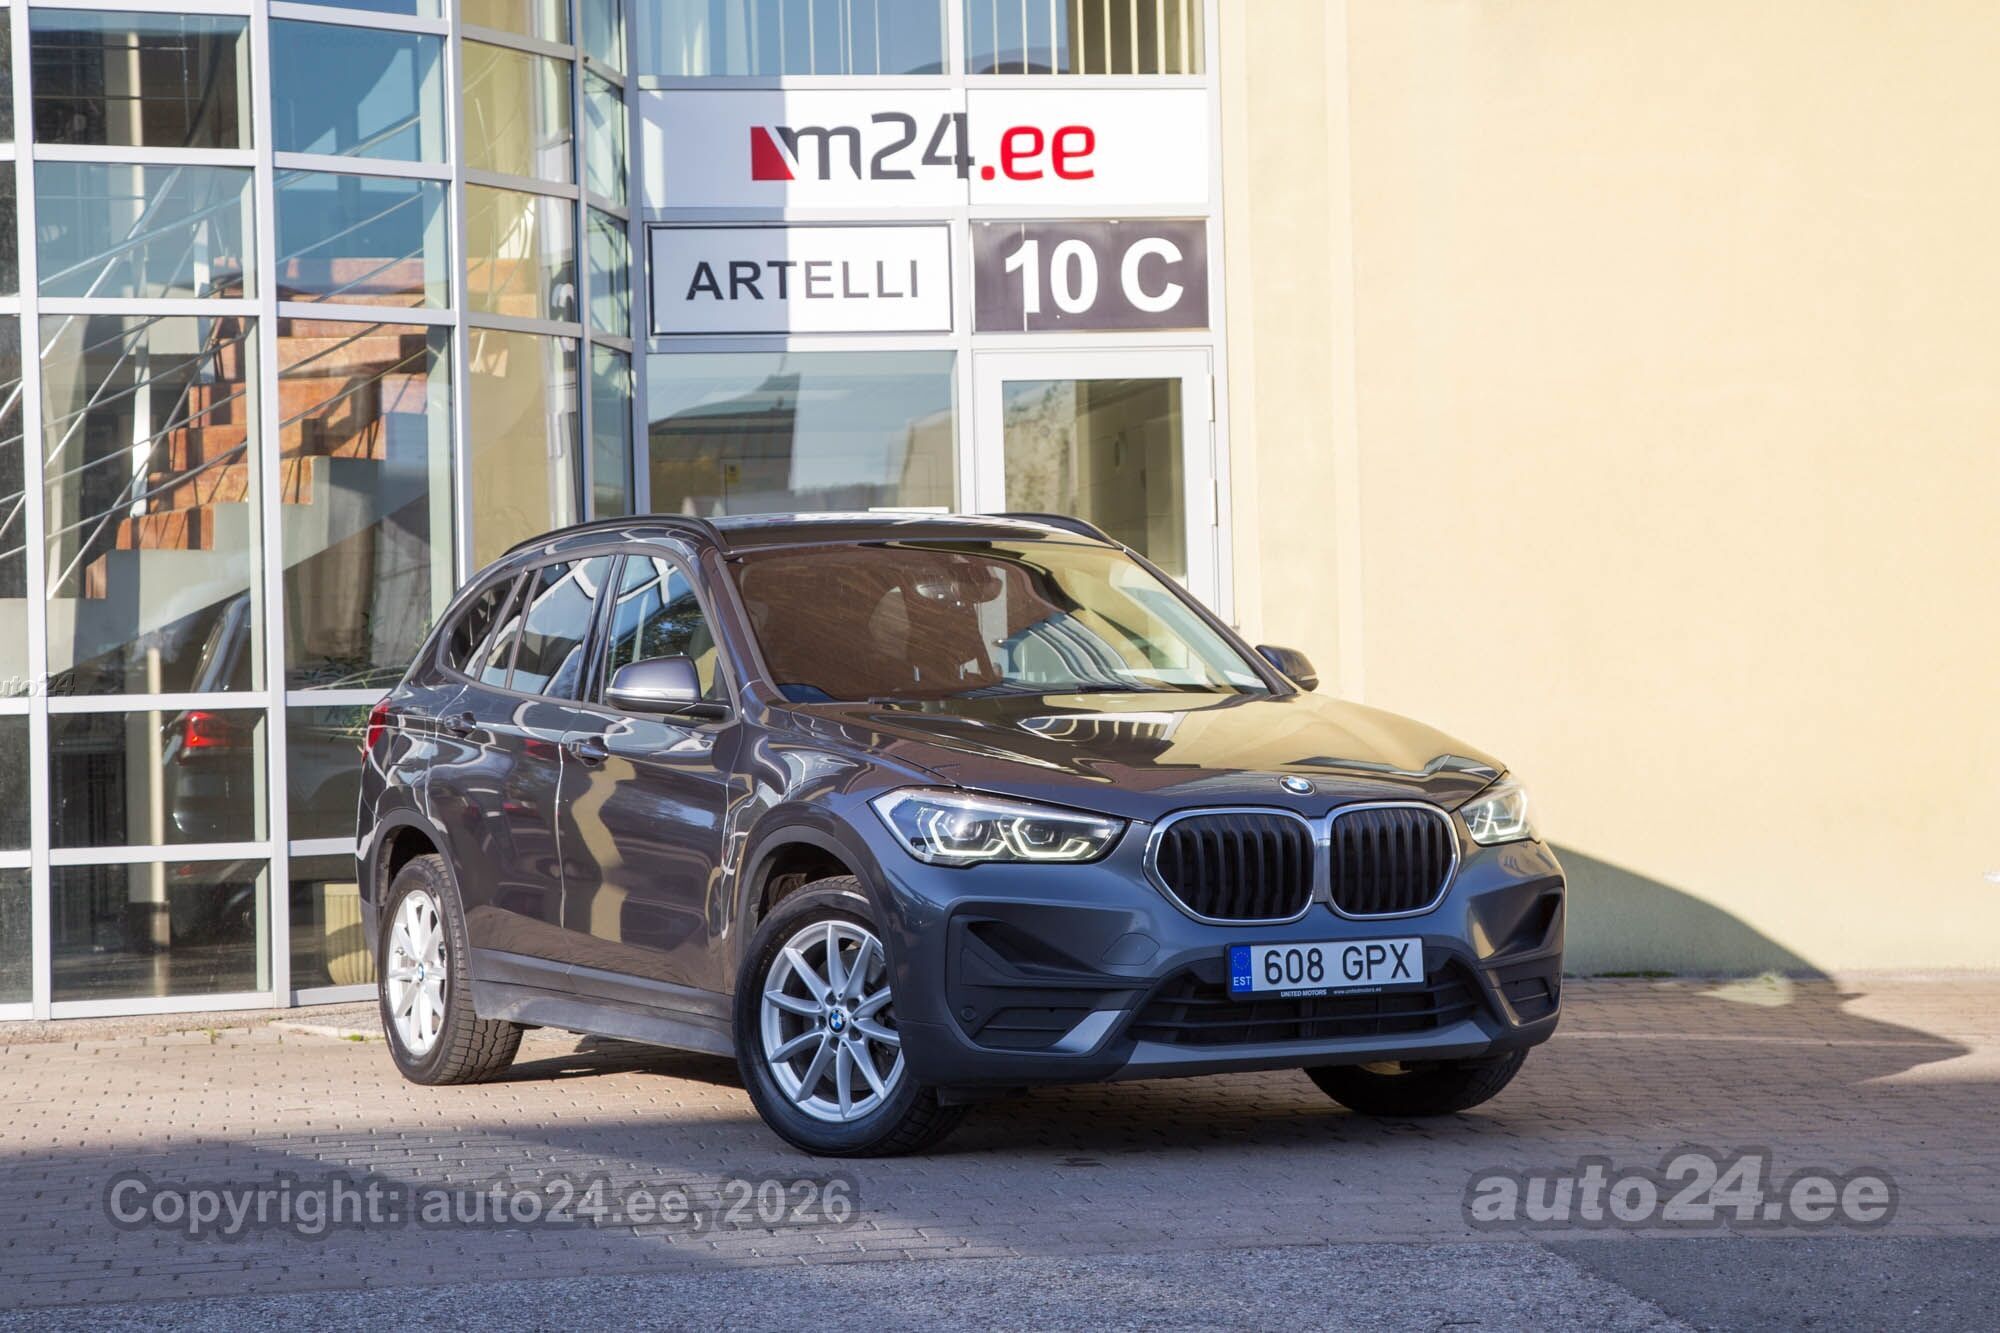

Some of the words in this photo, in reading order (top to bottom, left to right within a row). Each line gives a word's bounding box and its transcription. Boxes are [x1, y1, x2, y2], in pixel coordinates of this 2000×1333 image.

[686, 259, 919, 301] ARTELLI
[1004, 238, 1099, 315] 10
[1120, 236, 1185, 313] C
[1233, 976, 1251, 986] EST
[1264, 949, 1325, 985] 608
[1342, 942, 1411, 981] GPX
[1280, 990, 1301, 998] UNITED
[1302, 988, 1327, 996] MOTORS
